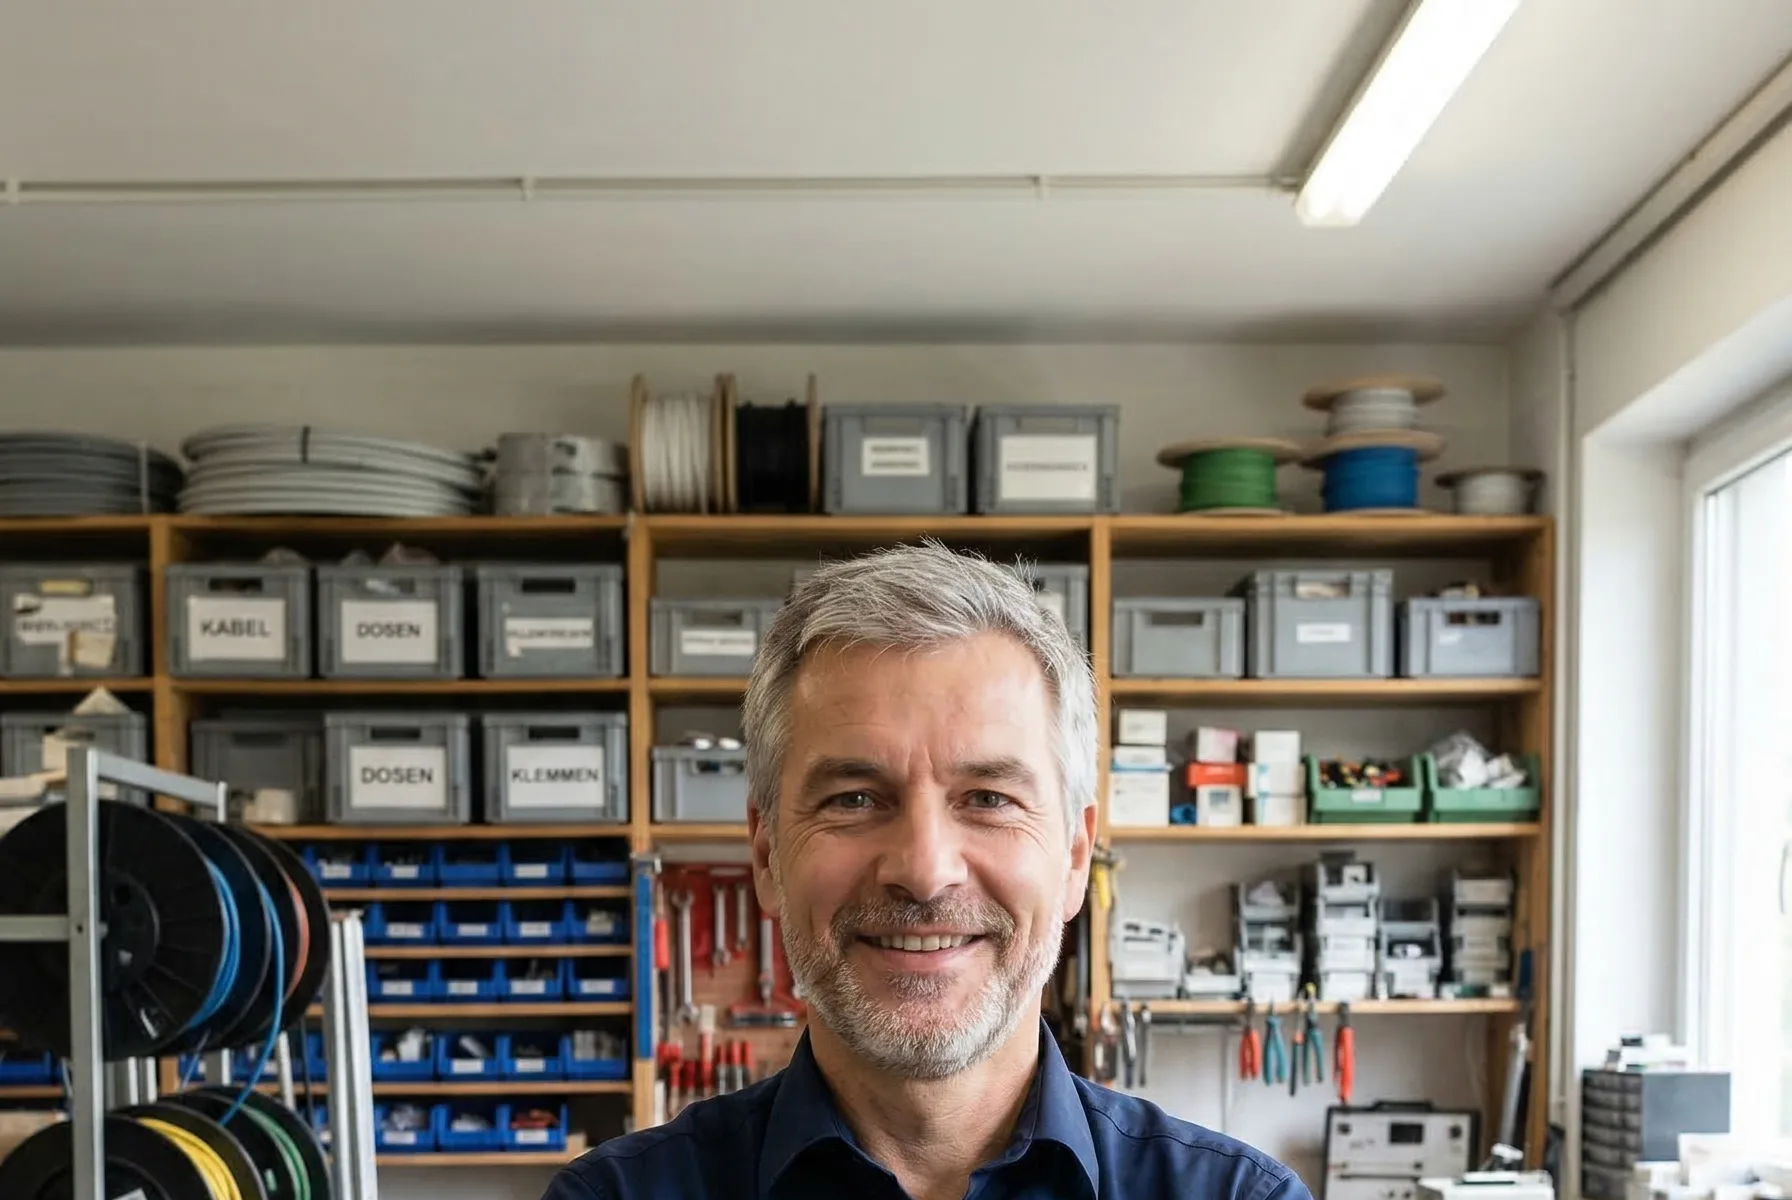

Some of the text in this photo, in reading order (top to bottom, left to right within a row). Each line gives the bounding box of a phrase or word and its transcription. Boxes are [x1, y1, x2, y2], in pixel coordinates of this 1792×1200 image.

[201, 619, 270, 637] KABEL
[356, 622, 421, 638] DOSEN
[361, 767, 434, 784] DOSEN
[511, 767, 600, 783] KLEMMEN
